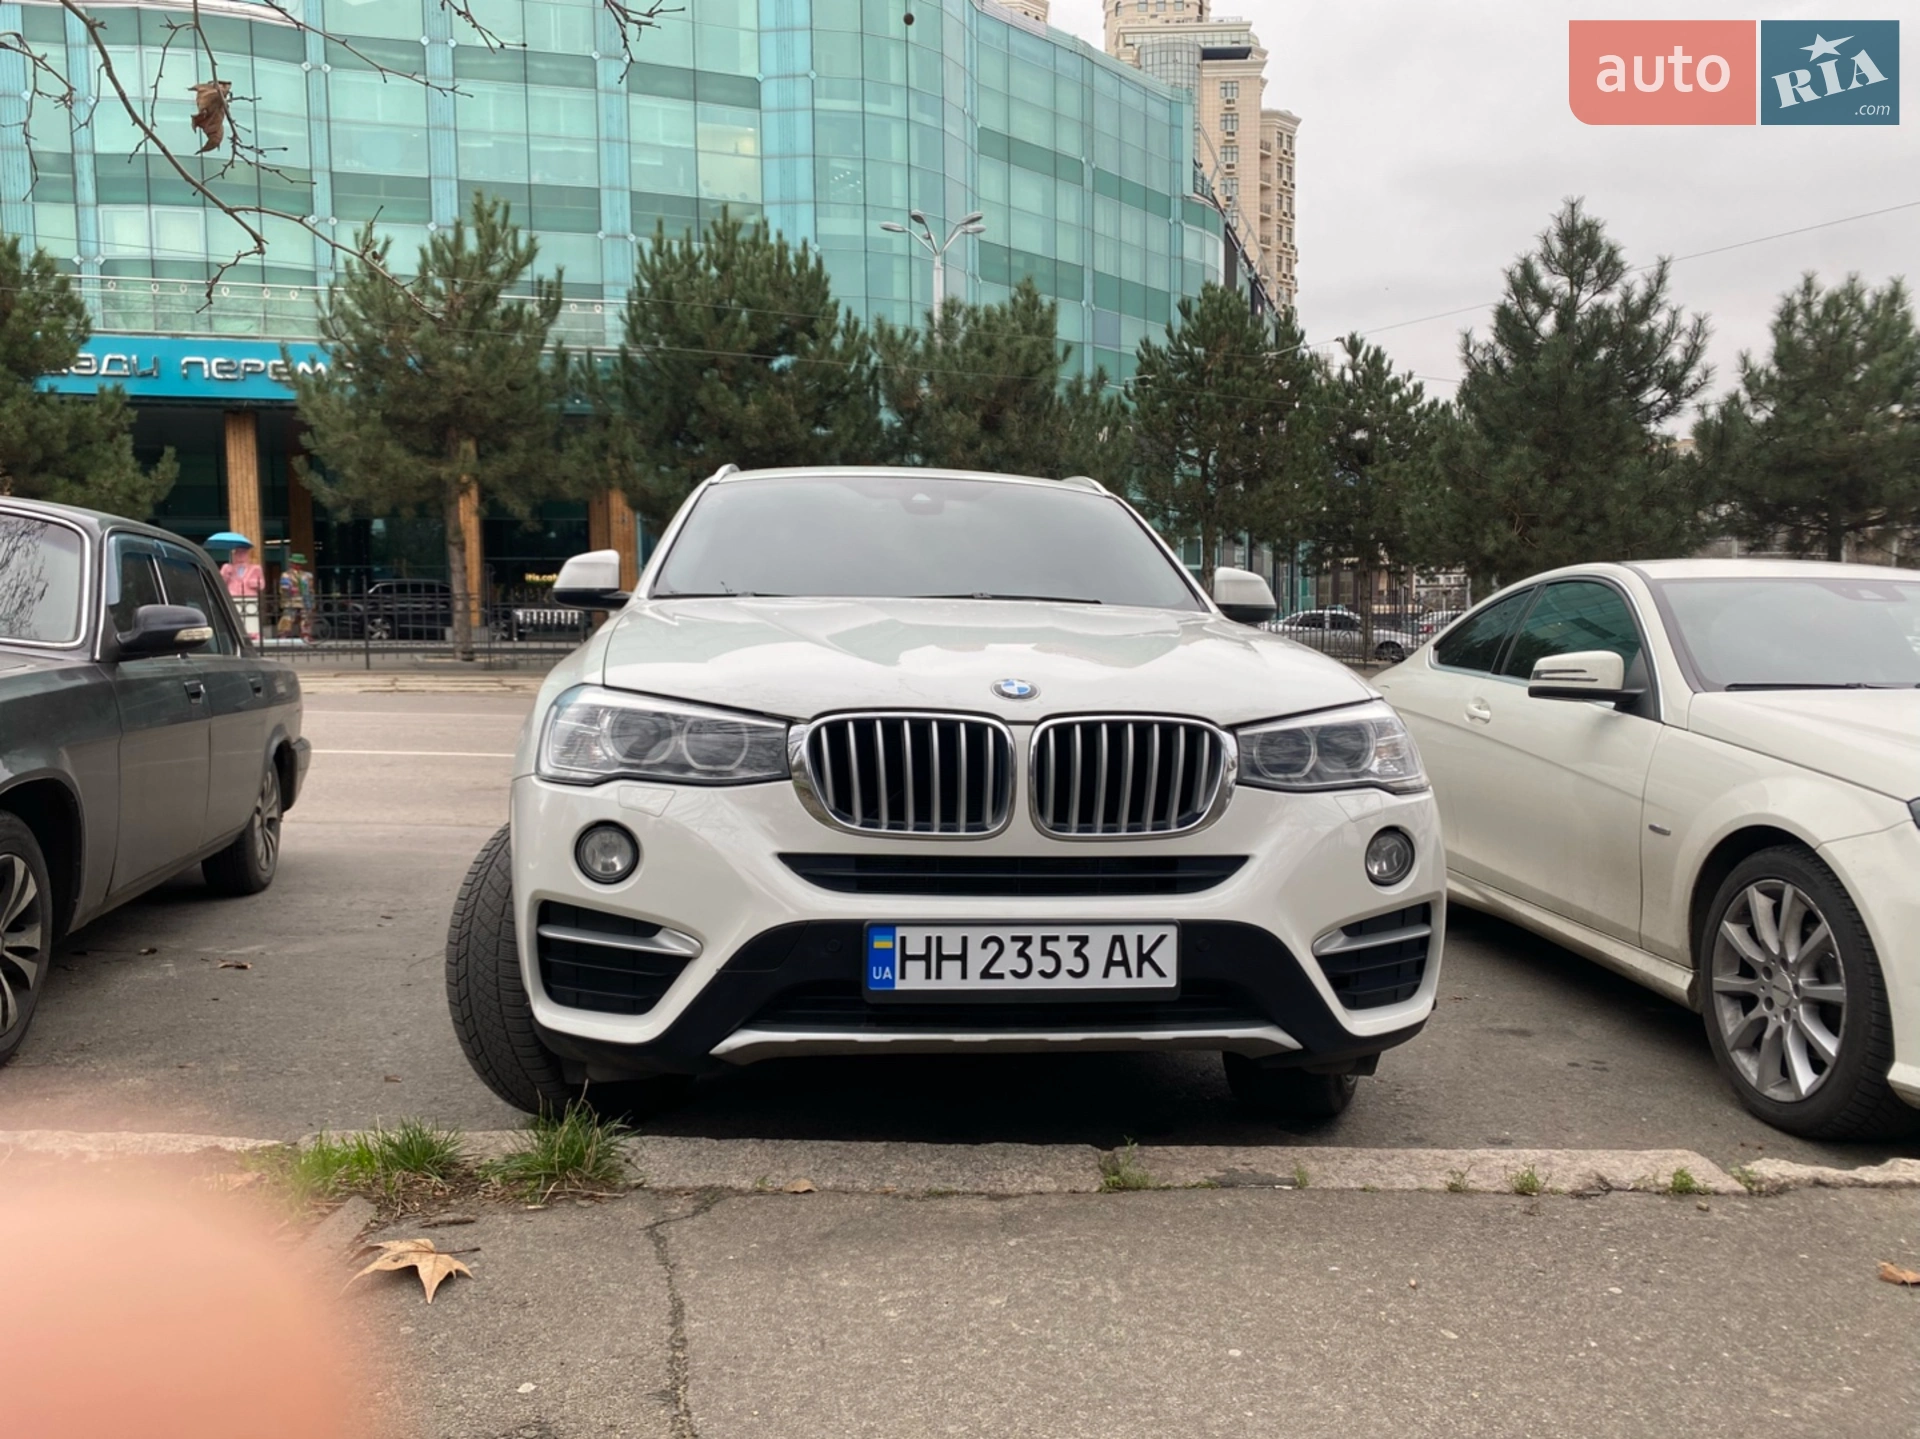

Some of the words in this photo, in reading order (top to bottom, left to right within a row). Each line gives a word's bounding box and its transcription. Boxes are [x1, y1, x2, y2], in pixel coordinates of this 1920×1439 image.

[899, 935, 968, 980] HH
[979, 934, 1090, 980] 2353
[1102, 934, 1168, 978] AK
[872, 967, 893, 980] UA
